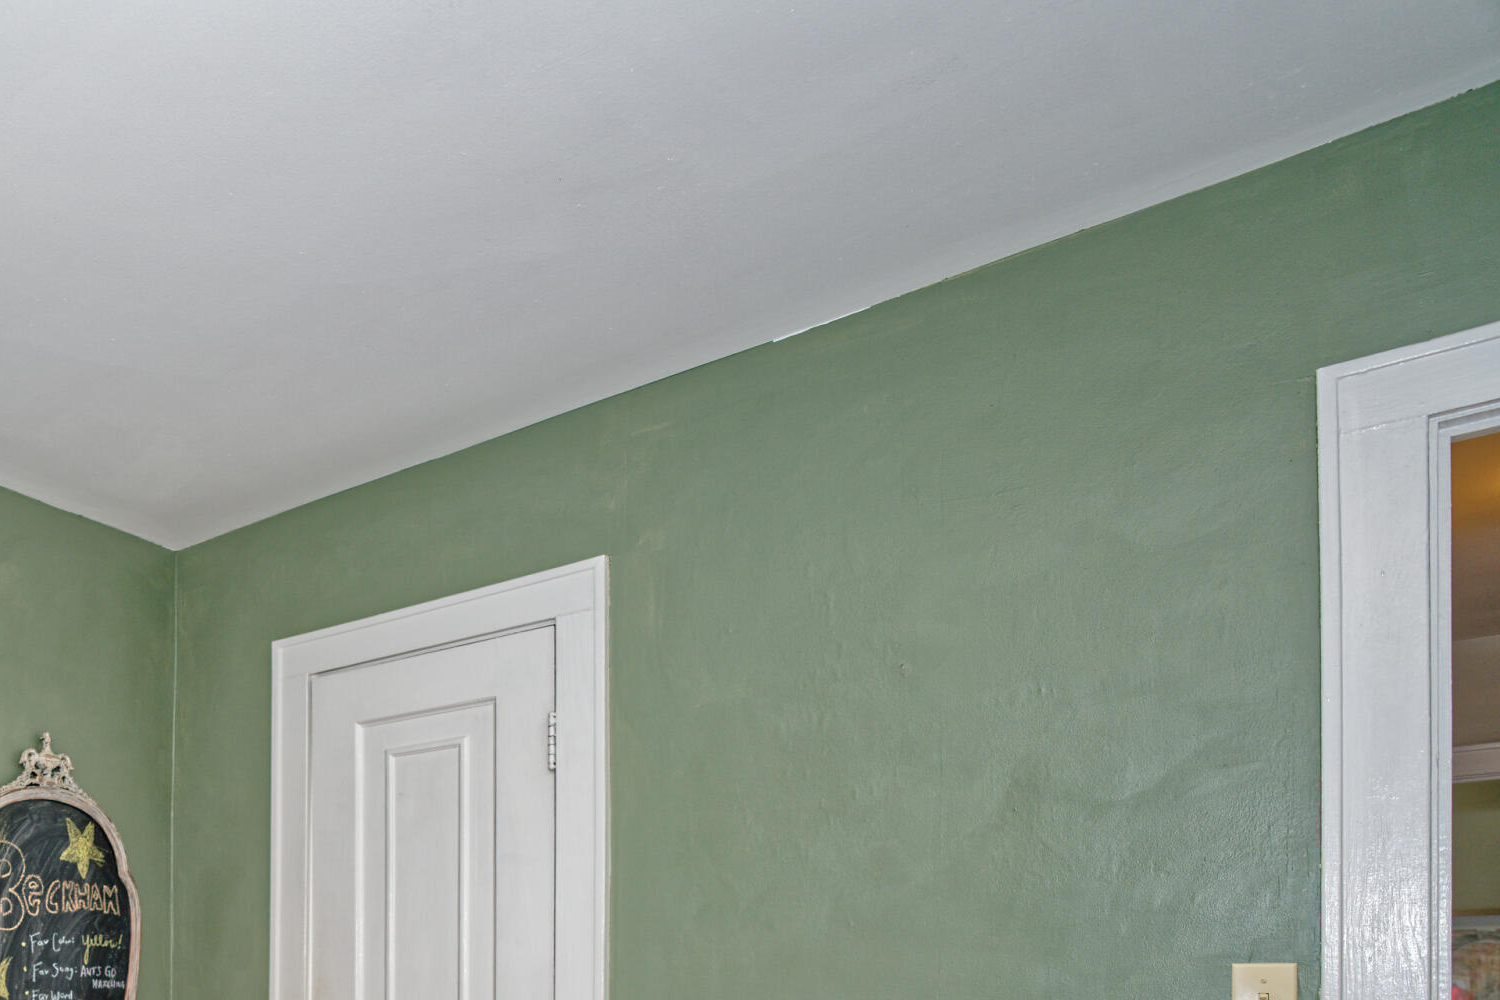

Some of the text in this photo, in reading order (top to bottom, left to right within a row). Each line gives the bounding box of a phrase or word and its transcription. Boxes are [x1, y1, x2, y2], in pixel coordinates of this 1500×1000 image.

[29, 931, 49, 954] Fav
[32, 961, 49, 983] Fav
[104, 965, 117, 978] GO
